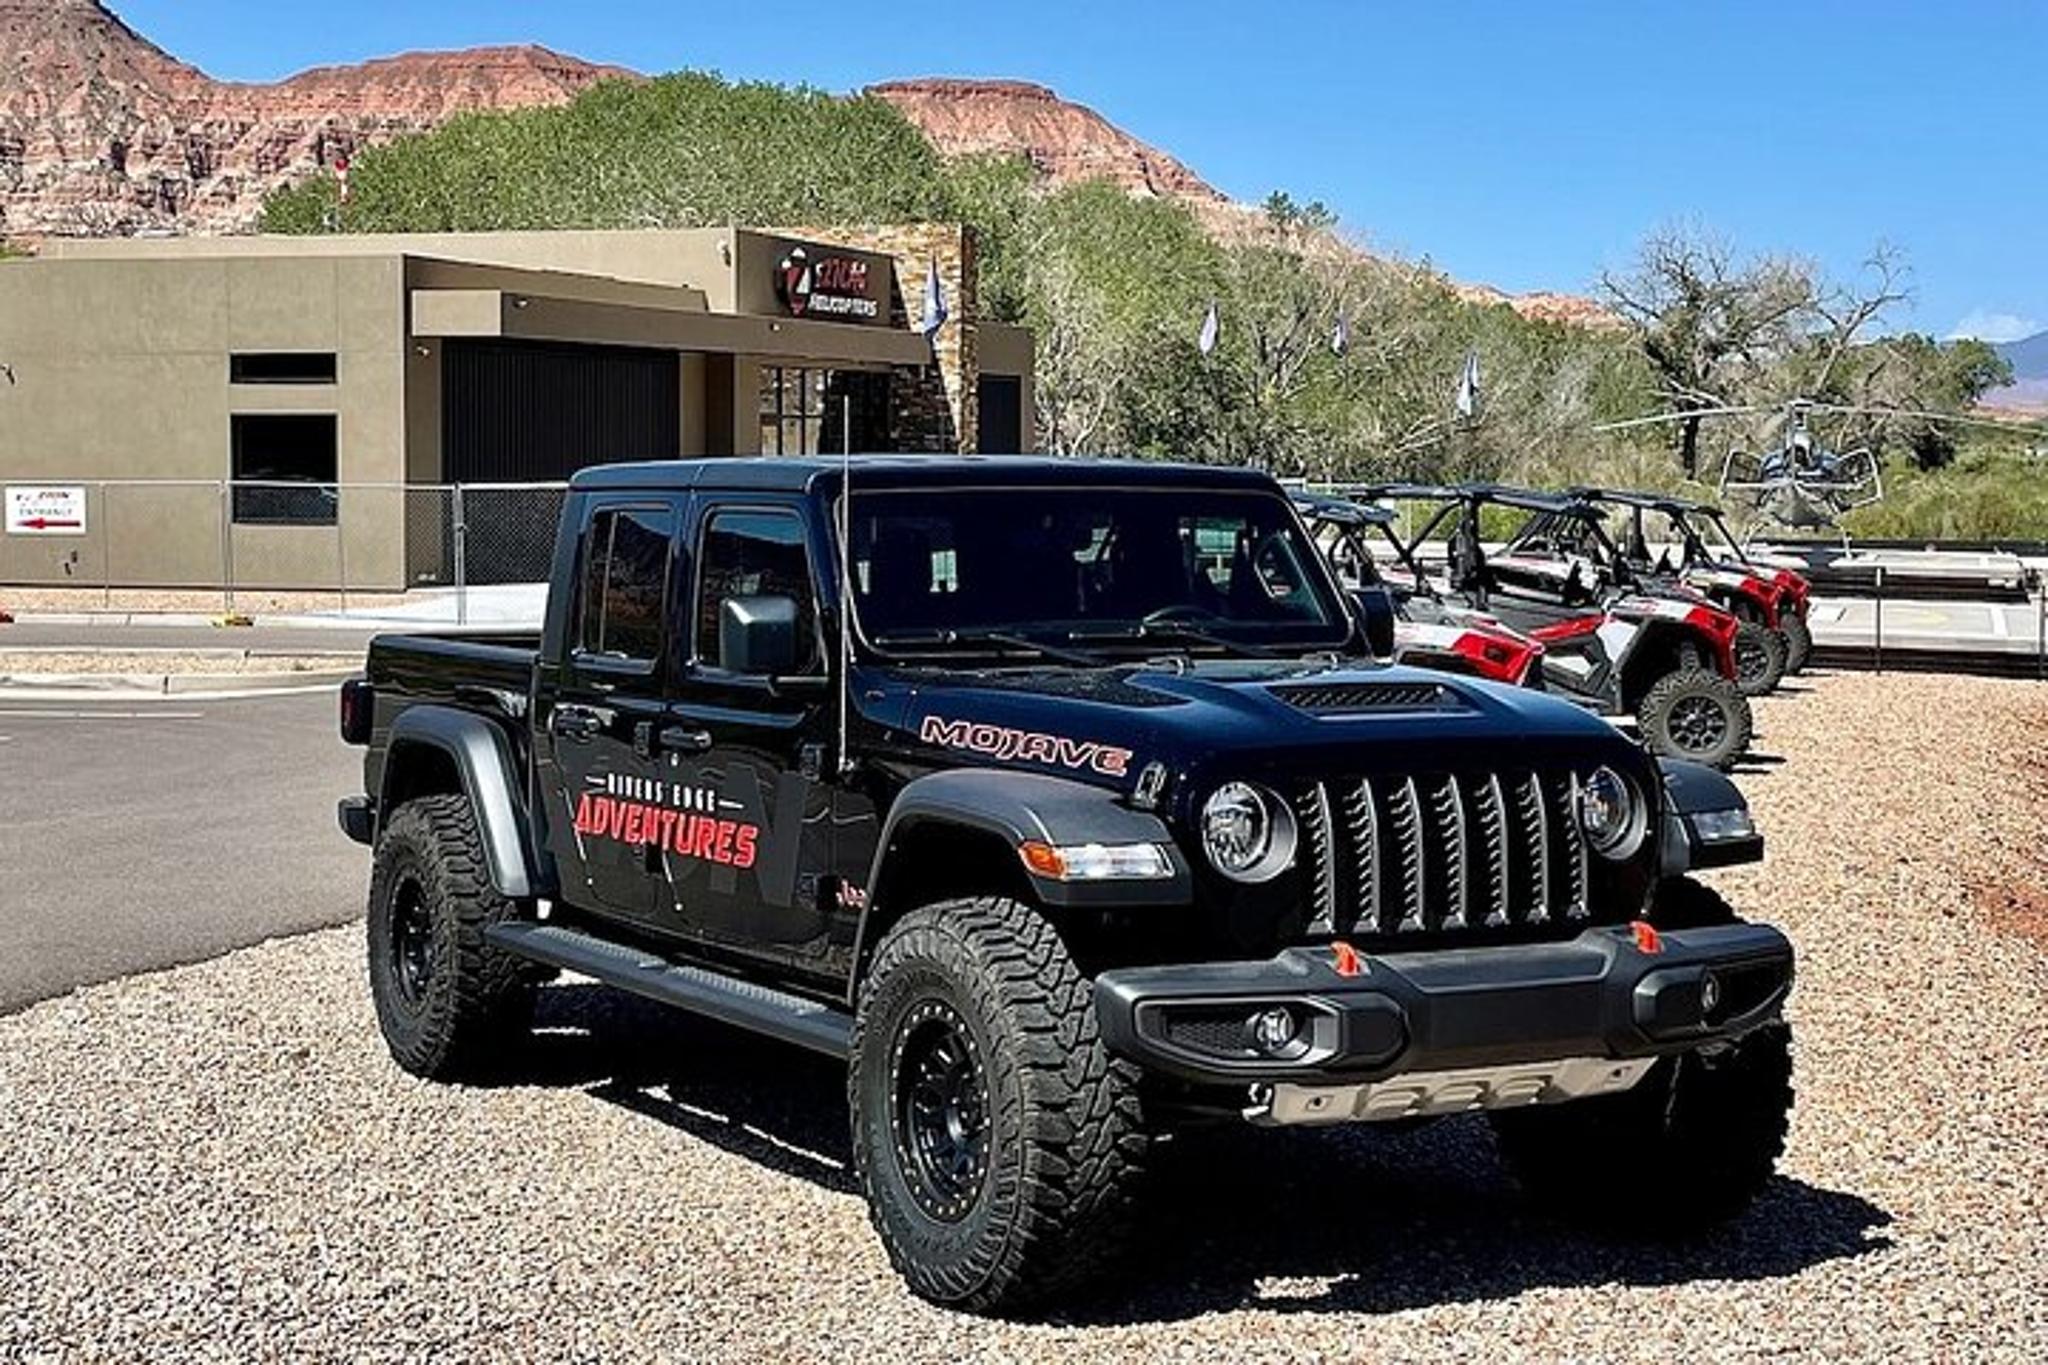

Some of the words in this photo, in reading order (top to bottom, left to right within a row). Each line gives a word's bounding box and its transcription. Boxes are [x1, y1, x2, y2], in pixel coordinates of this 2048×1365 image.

[920, 715, 1134, 777] MOJAVE
[673, 783, 716, 812] EDGE
[576, 792, 760, 869] ADVENTURES
